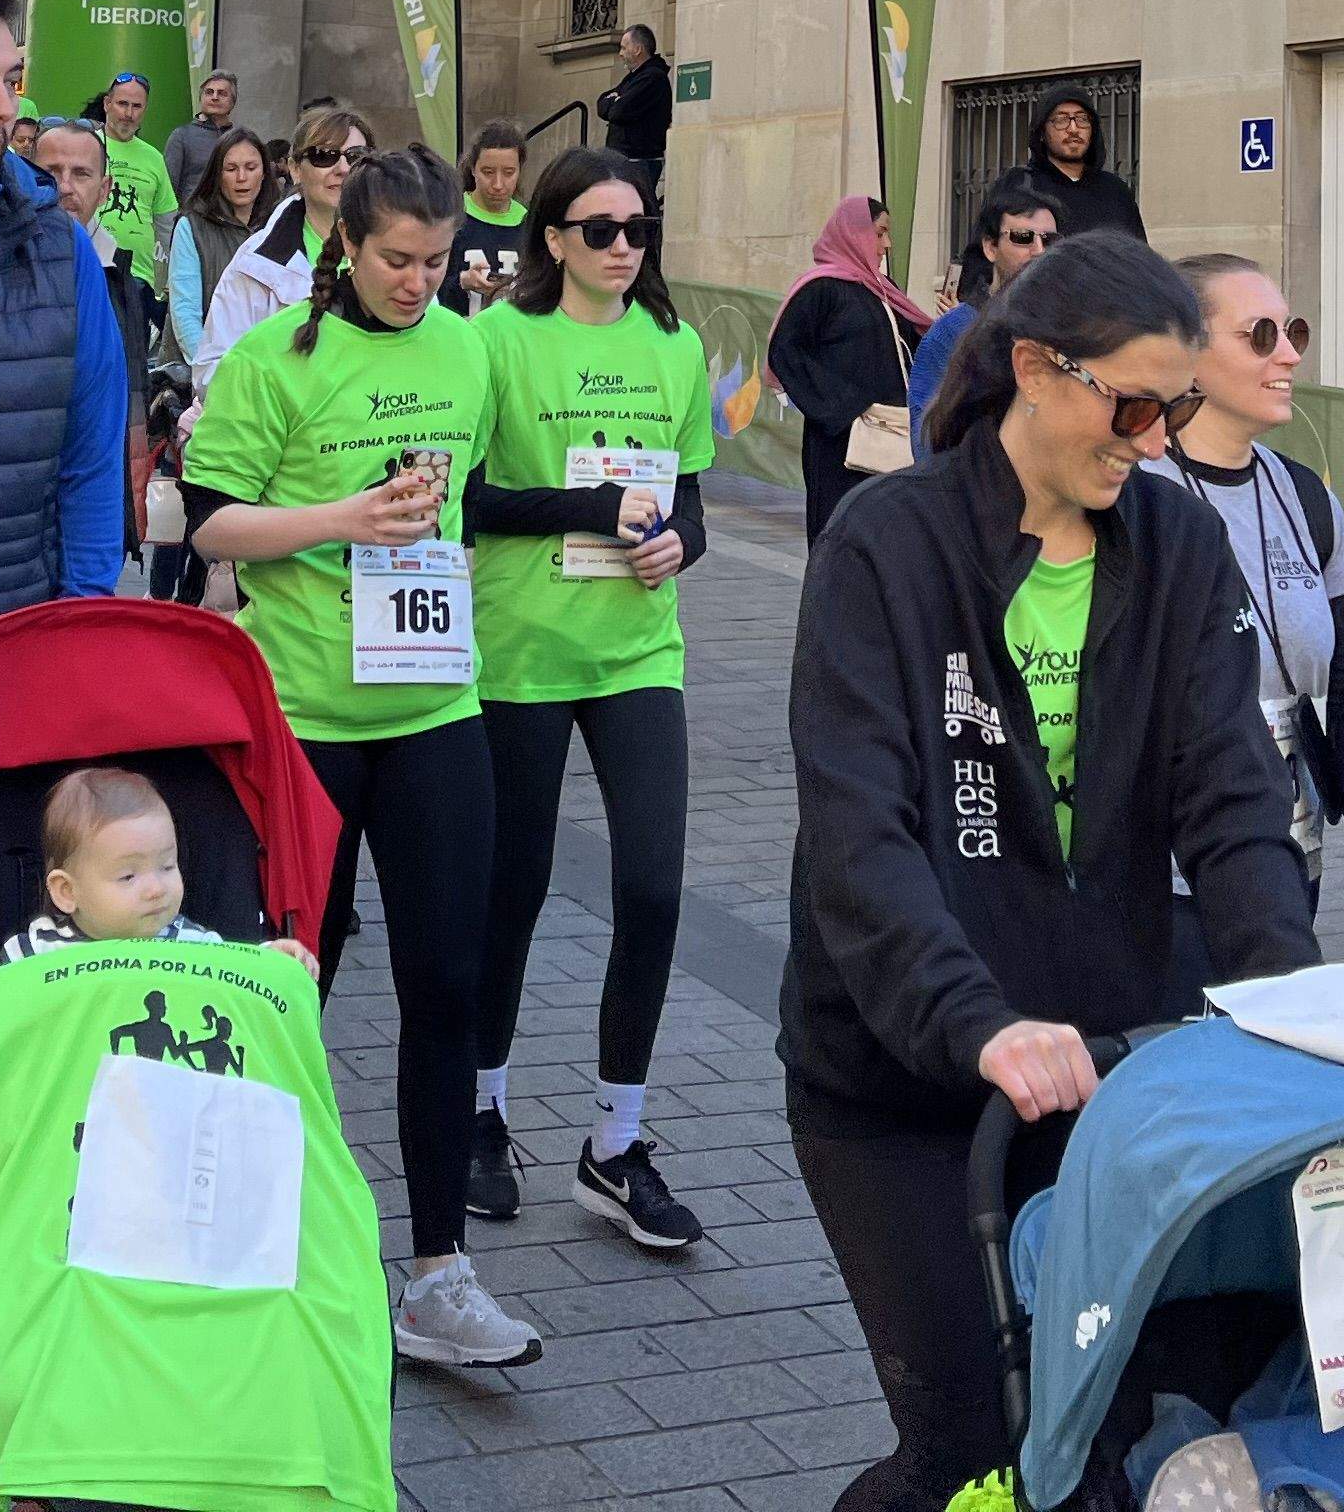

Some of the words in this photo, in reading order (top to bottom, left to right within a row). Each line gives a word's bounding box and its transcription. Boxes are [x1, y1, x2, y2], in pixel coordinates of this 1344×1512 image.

[90, 6, 186, 27] IBERDRO
[592, 371, 624, 386] TOUR
[584, 385, 628, 396] UNIVERSO
[375, 405, 423, 420] UNIVERSO
[424, 400, 453, 413] MUJER
[382, 392, 418, 410] TOUR
[538, 411, 553, 422] EN
[556, 409, 591, 420] FORMA
[594, 410, 615, 419] POR
[617, 410, 631, 420] LA
[320, 443, 338, 454] EN
[341, 437, 385, 451] FORMA
[387, 433, 410, 445] POR
[413, 432, 427, 442] LA
[429, 432, 471, 442] IGUALDAD
[389, 588, 450, 634] 165
[1034, 648, 1080, 672] TOU
[1024, 671, 1080, 687] UNIVER
[945, 688, 1001, 726] HUESCA
[1036, 712, 1073, 727] POR
[44, 967, 69, 983] EN
[74, 957, 143, 976] FORMA
[148, 959, 186, 974] POR
[191, 963, 213, 979] LA
[217, 967, 288, 1015] IGUALDAD
